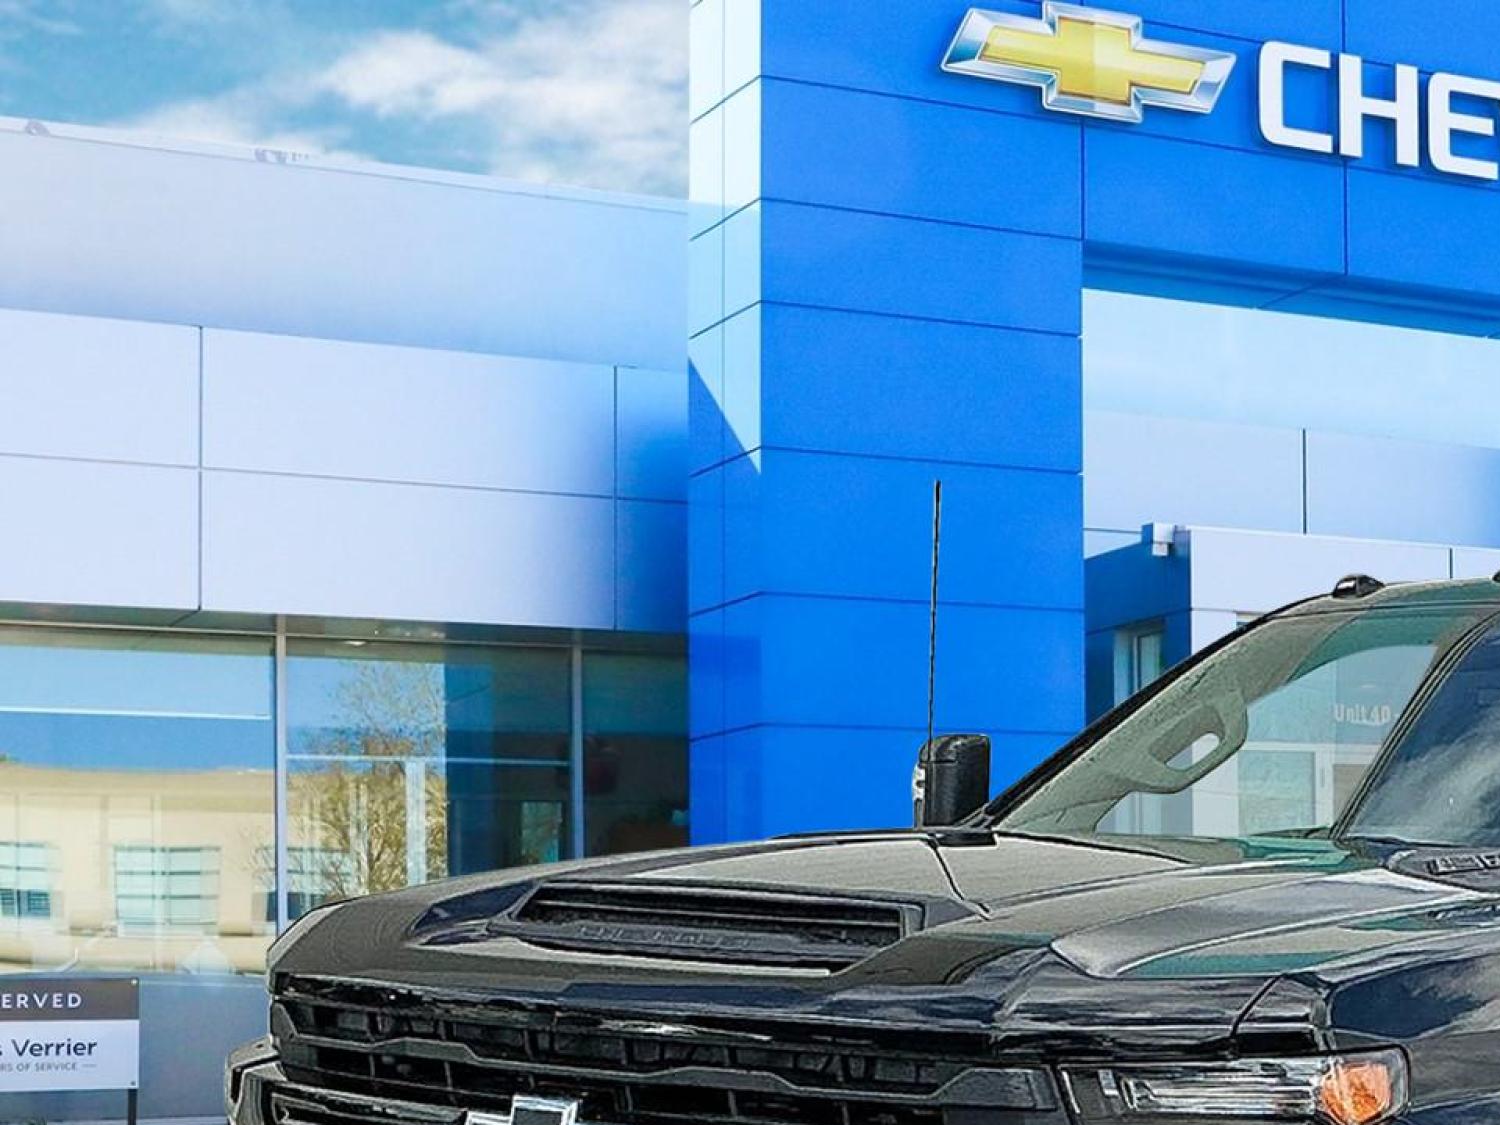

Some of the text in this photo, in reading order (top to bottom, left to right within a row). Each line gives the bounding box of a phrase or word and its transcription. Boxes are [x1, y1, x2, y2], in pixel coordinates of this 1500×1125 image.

[2, 992, 83, 1009] ERVED
[11, 1038, 98, 1056] Verrier
[16, 1062, 30, 1072] OF
[35, 1062, 77, 1072] SERVICE
